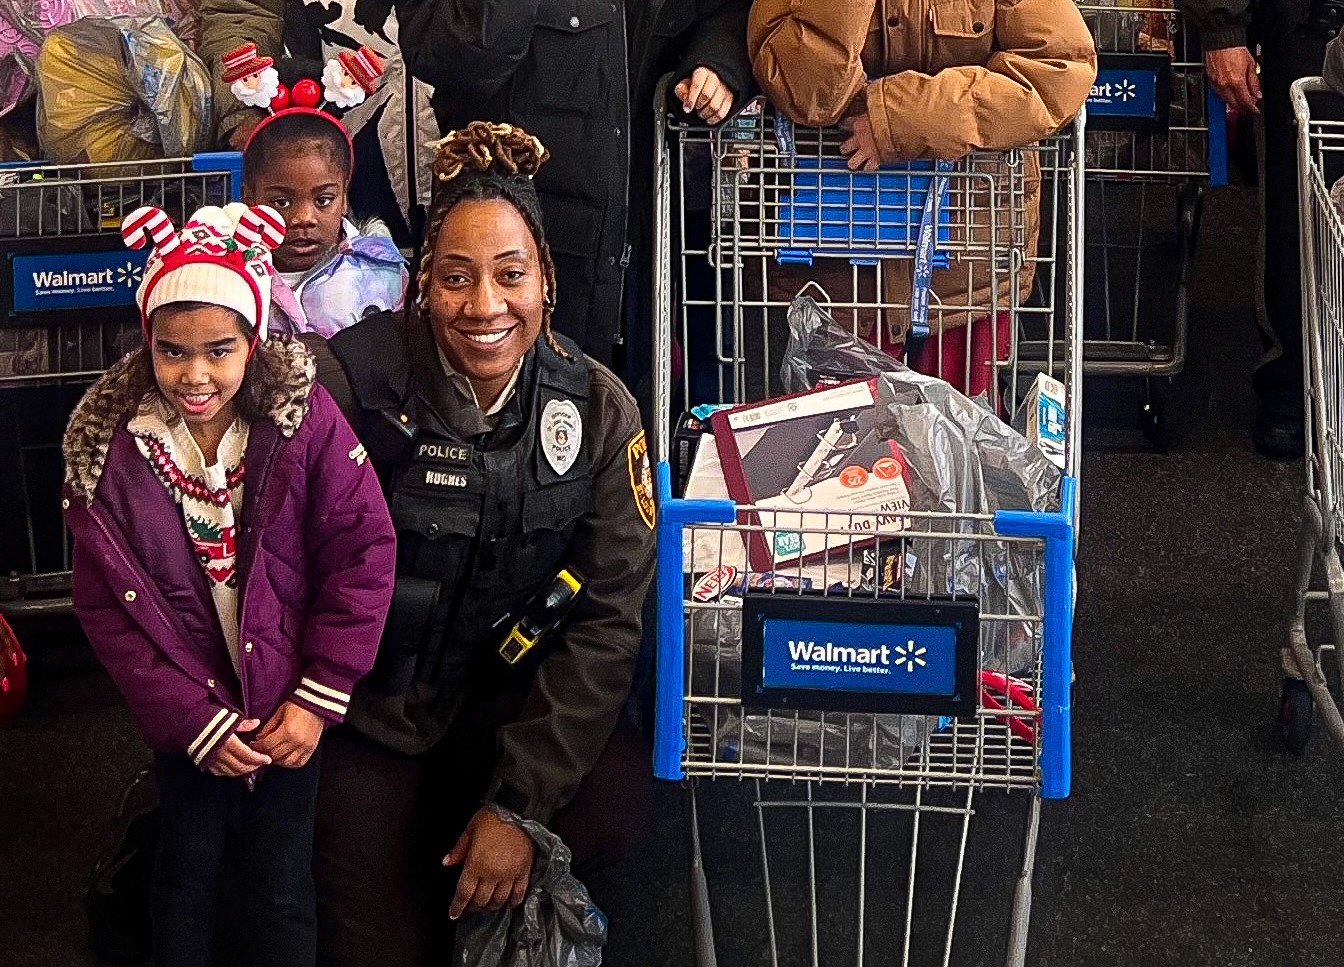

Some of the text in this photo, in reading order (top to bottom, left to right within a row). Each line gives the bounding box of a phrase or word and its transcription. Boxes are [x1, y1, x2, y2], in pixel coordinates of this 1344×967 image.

[32, 268, 113, 288] Walmart
[418, 444, 467, 460] POLICE
[425, 470, 468, 487] HUGHES
[880, 499, 911, 512] VIEW
[695, 569, 728, 600] NERF
[788, 640, 890, 664] Walmart
[790, 663, 892, 674] Save money. Live better.
